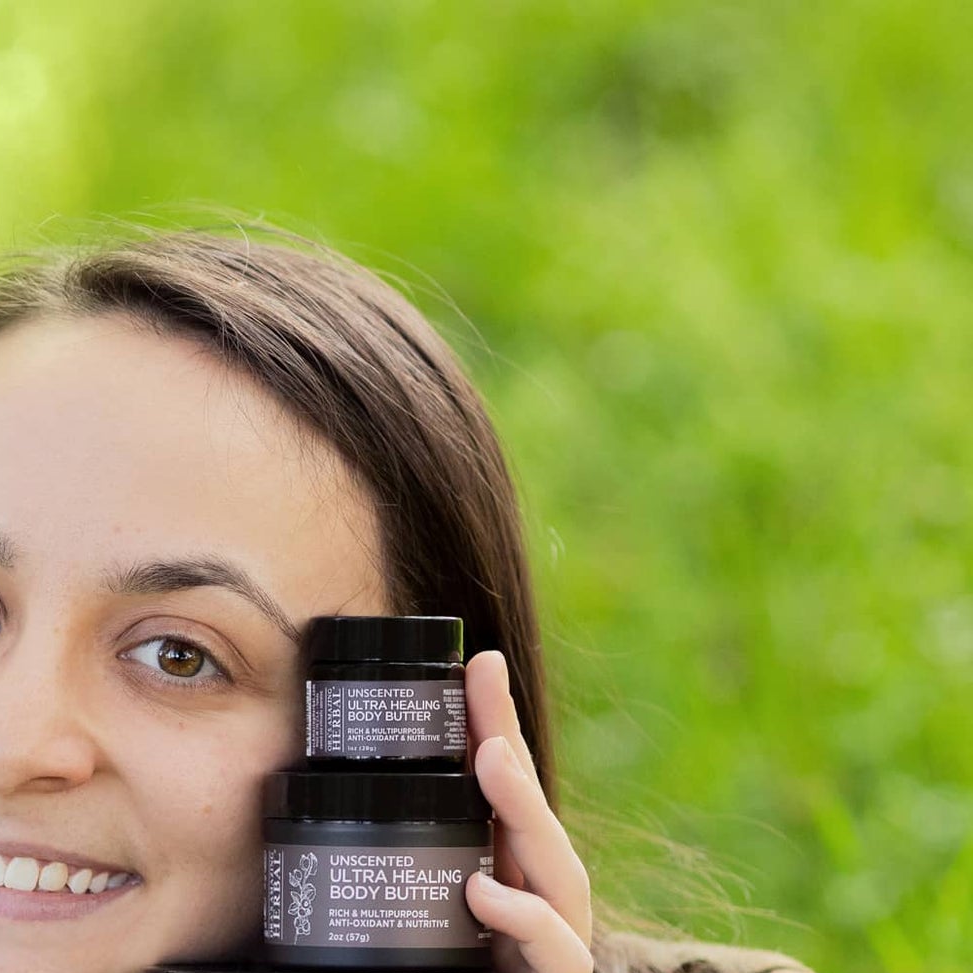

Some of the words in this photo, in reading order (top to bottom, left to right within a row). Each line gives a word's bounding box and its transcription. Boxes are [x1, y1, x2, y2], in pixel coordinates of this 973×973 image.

[347, 688, 414, 698] UNSCENTED
[347, 700, 387, 710] ULTRA
[390, 699, 441, 711] HEALING
[332, 688, 341, 752] HERBAL
[347, 711, 383, 722] BODY
[385, 711, 431, 722] BUTTER
[330, 855, 414, 867] UNSCENTED
[330, 869, 387, 884] ULTRA
[392, 869, 462, 884] HEALING
[273, 852, 281, 938] HERBAL
[330, 886, 379, 900] BODY
[385, 886, 449, 900] BUTTER
[328, 909, 350, 918] RICH
[351, 910, 358, 918] &
[360, 910, 429, 918] MULTIPURPOSE
[328, 919, 395, 928] ANTI-OXIDANT
[396, 920, 403, 928] &
[405, 920, 449, 928] NUTRITIVE
[328, 932, 343, 941] 2oz
[345, 932, 370, 943] (57g)
